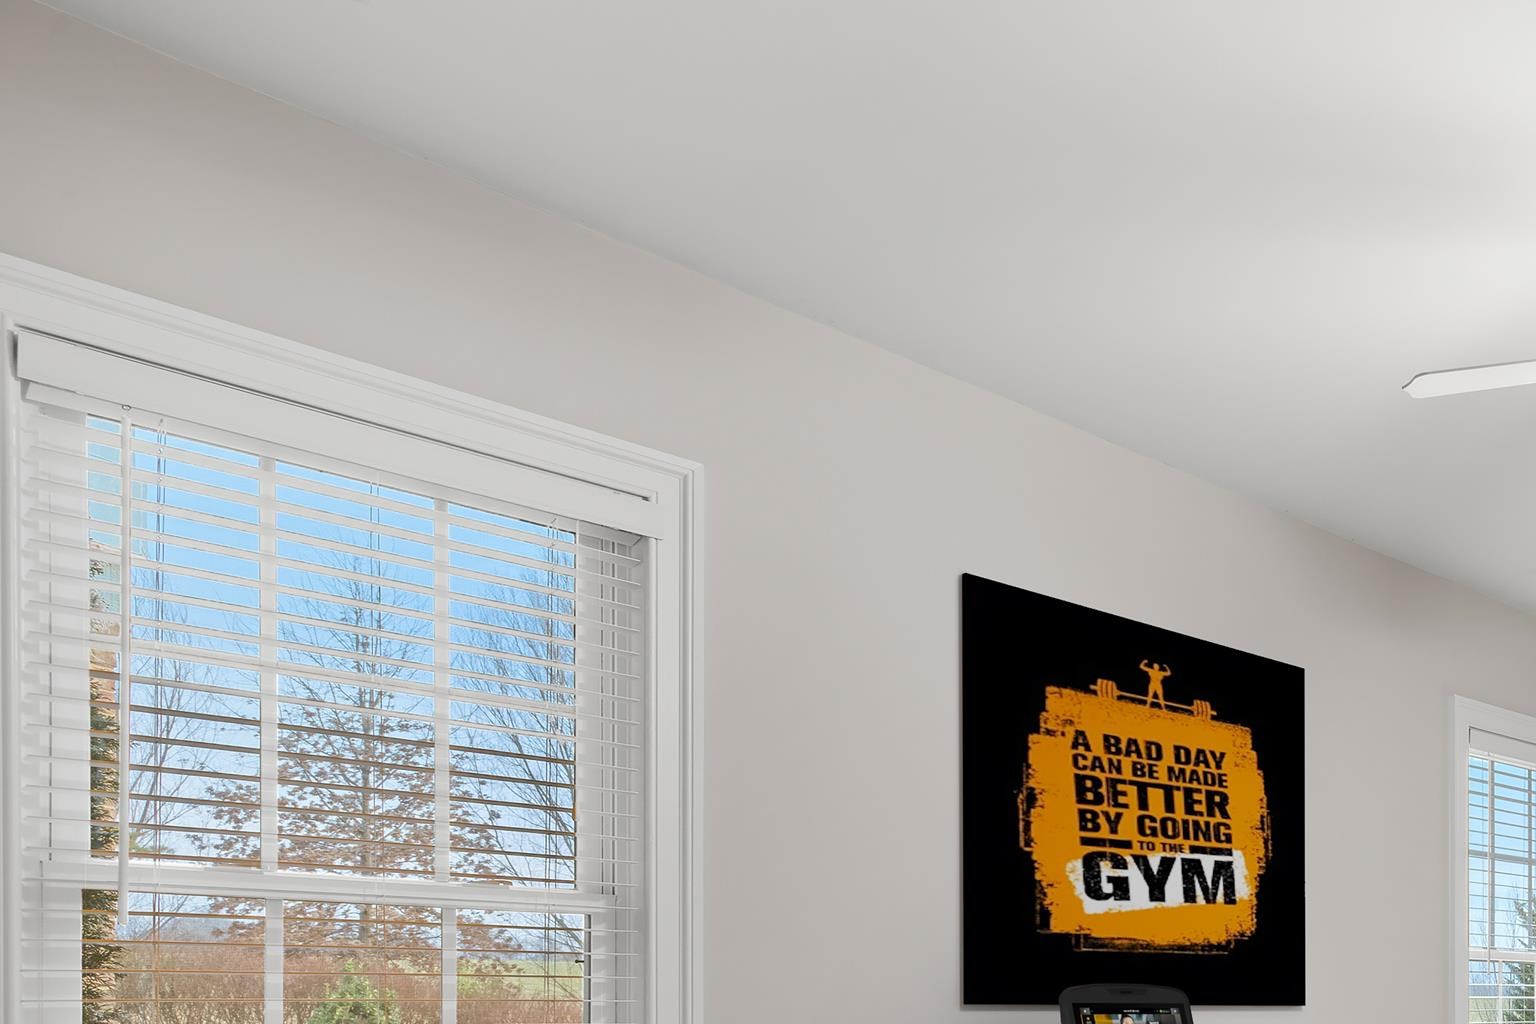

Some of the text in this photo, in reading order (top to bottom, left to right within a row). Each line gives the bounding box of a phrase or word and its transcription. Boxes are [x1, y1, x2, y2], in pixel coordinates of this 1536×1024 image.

[1071, 729, 1226, 770] A BAD DAY
[1072, 753, 1228, 789] CAN BE MADE
[1073, 773, 1232, 820] BETTER
[1077, 808, 1232, 844] BY GOING
[1137, 840, 1186, 854] TO THE
[1082, 851, 1237, 905] GYM
